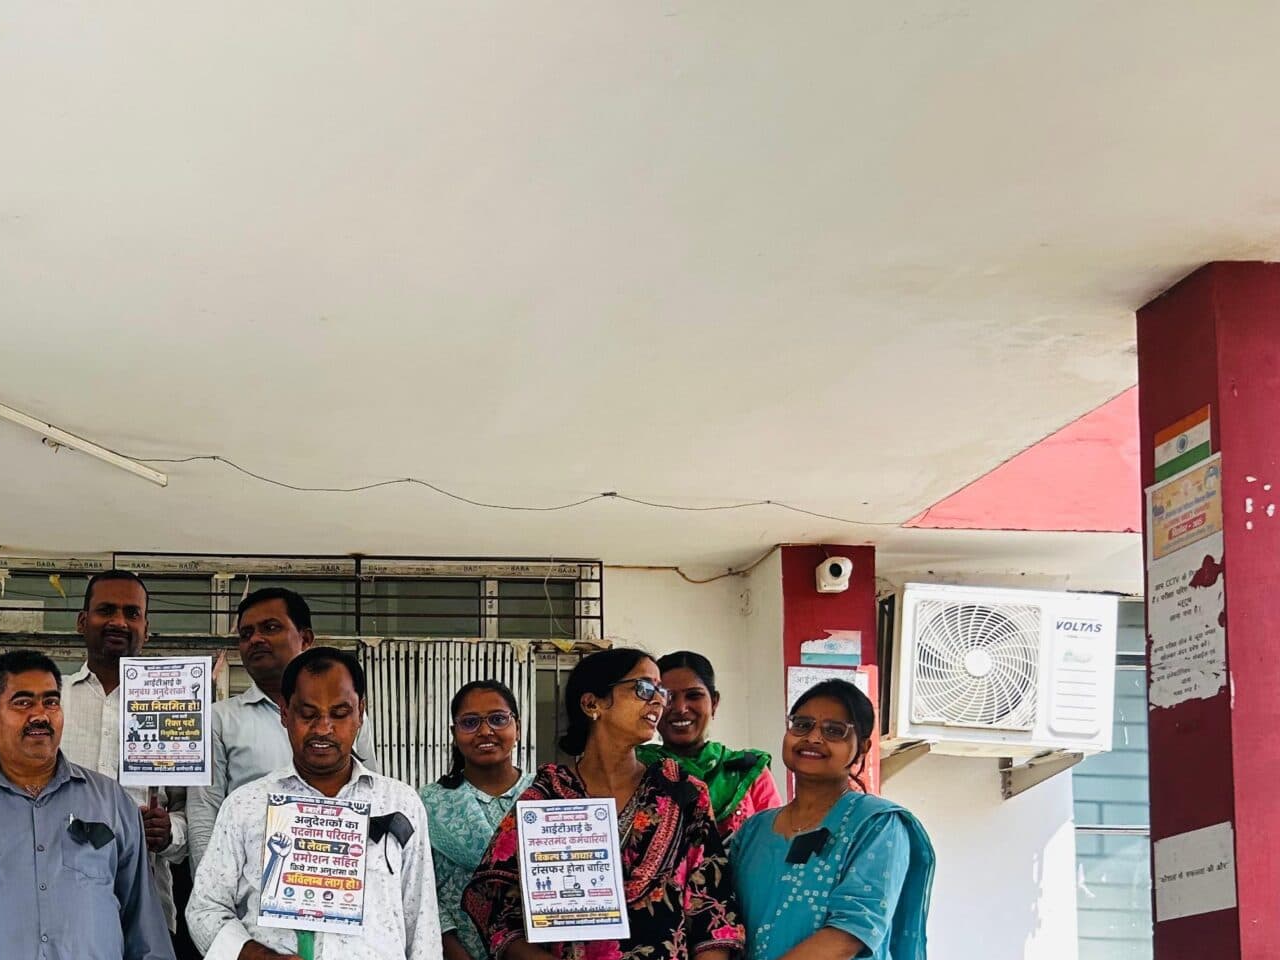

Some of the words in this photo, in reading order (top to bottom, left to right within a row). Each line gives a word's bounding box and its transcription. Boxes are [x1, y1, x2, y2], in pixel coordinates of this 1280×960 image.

[1165, 576, 1179, 587] CCTV
[1056, 621, 1102, 633] VOLTAS
[144, 678, 174, 687] आईटीआई
[130, 701, 148, 712] सेवा
[152, 700, 186, 712] नियमित
[188, 701, 200, 712] हो!
[295, 815, 342, 828] अनुदेशकों
[345, 821, 359, 830] का
[541, 822, 582, 834] आईटीआई
[584, 823, 593, 831] के
[291, 827, 324, 839] पदनाम
[326, 828, 364, 844] परिवर्तन,
[527, 837, 567, 847] जरूरतमंद
[569, 834, 608, 845] कर्मचारियों
[297, 840, 306, 850] पे
[308, 841, 331, 852] लेवल
[292, 852, 330, 864] प्रमोशन
[332, 855, 359, 868] सहित
[290, 862, 305, 872] किये
[532, 865, 564, 875] ट्रांसफर
[567, 864, 585, 874] होना
[587, 862, 611, 872] चाहिए
[287, 873, 323, 885] अविलम्ब
